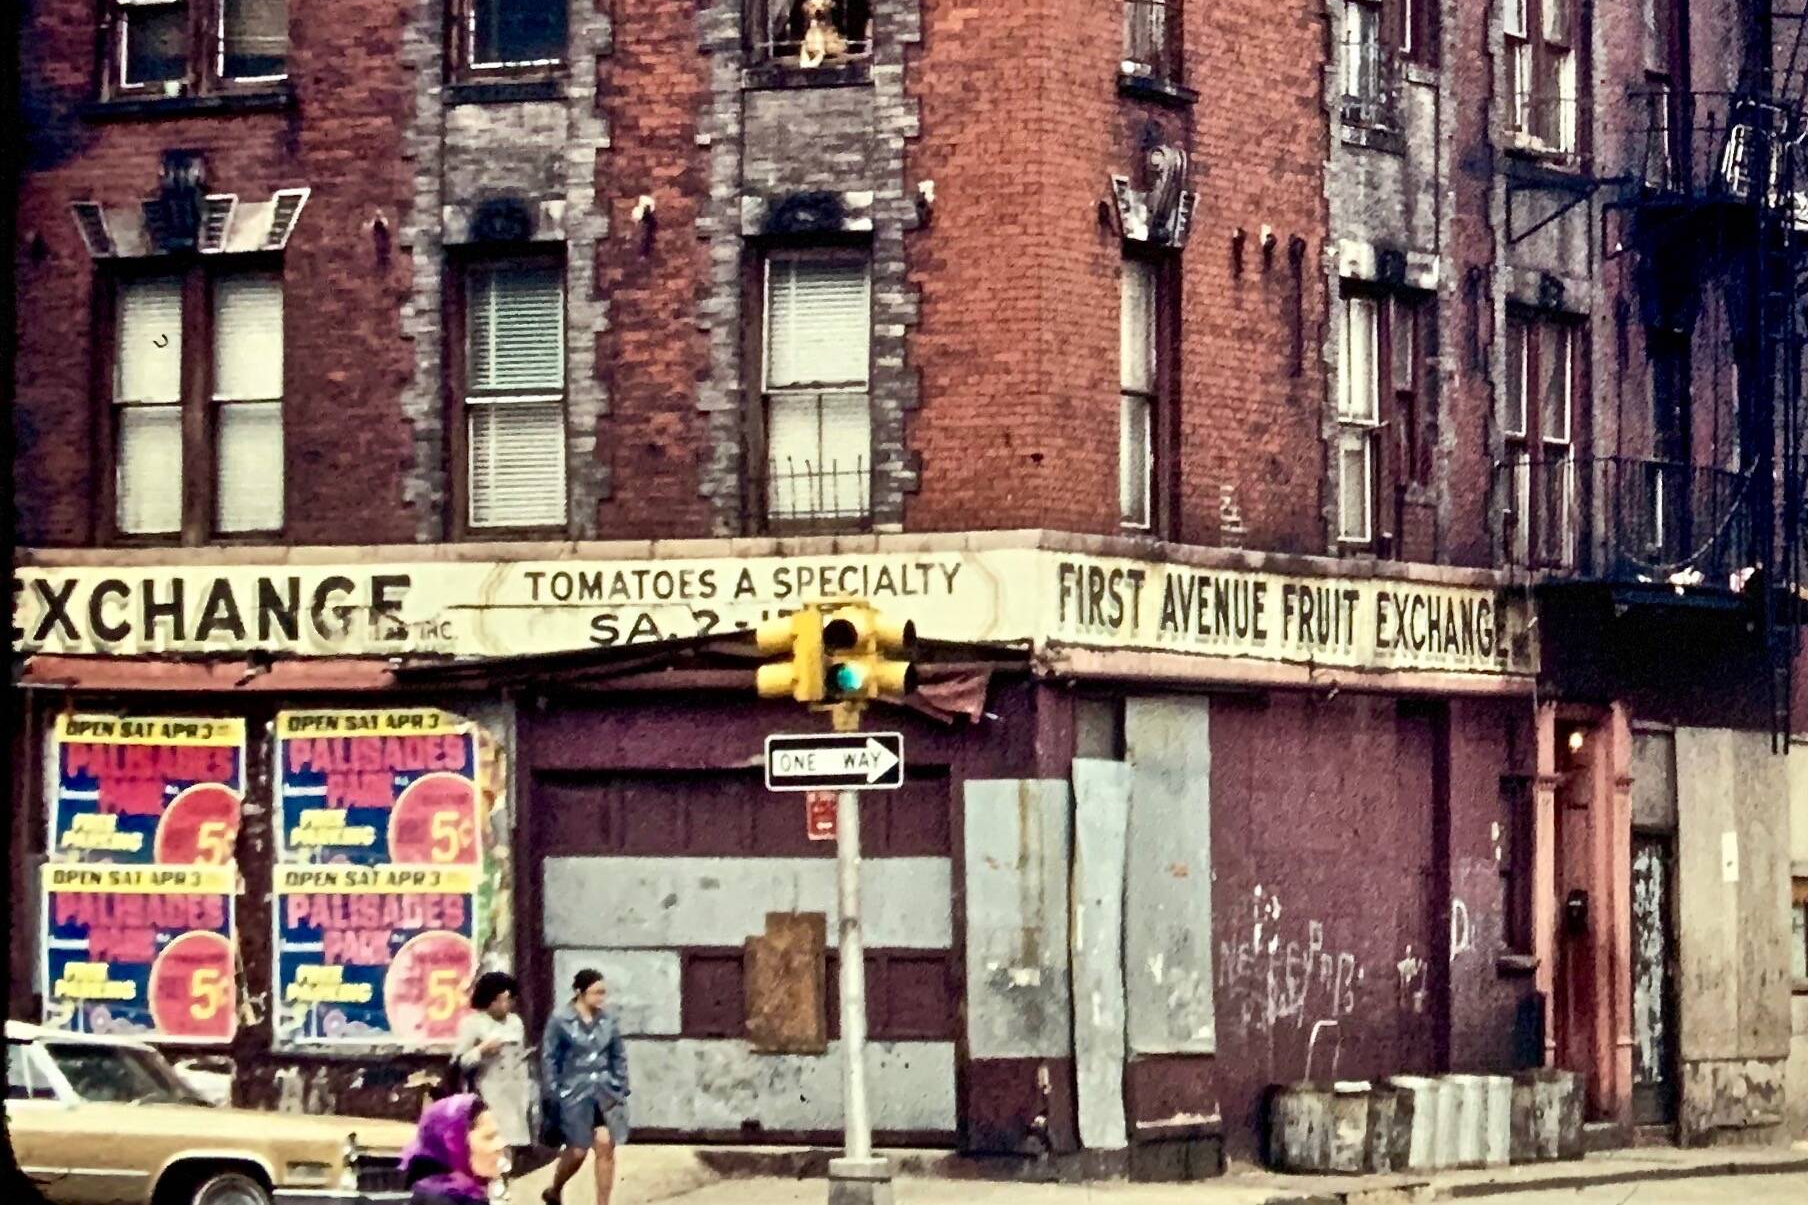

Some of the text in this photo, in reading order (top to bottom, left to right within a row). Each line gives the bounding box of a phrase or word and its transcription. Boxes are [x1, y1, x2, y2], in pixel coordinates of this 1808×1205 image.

[524, 562, 962, 603] TOMATOES A SPECIALTY
[1059, 562, 1509, 658] FIRST AVENUE FRUIT EXCHANGE
[65, 721, 115, 737] OPEN
[120, 722, 154, 738] SAT
[161, 723, 198, 739] APR
[202, 723, 213, 740] 3
[287, 714, 440, 731] OPEN SAT APR 3
[289, 734, 466, 773] PALISADES
[780, 750, 882, 772] ONE WAY
[53, 869, 201, 886] OPEN SAT APR 3
[285, 871, 441, 886] OPEN SAT APR 3
[287, 893, 465, 929] PALISADES
